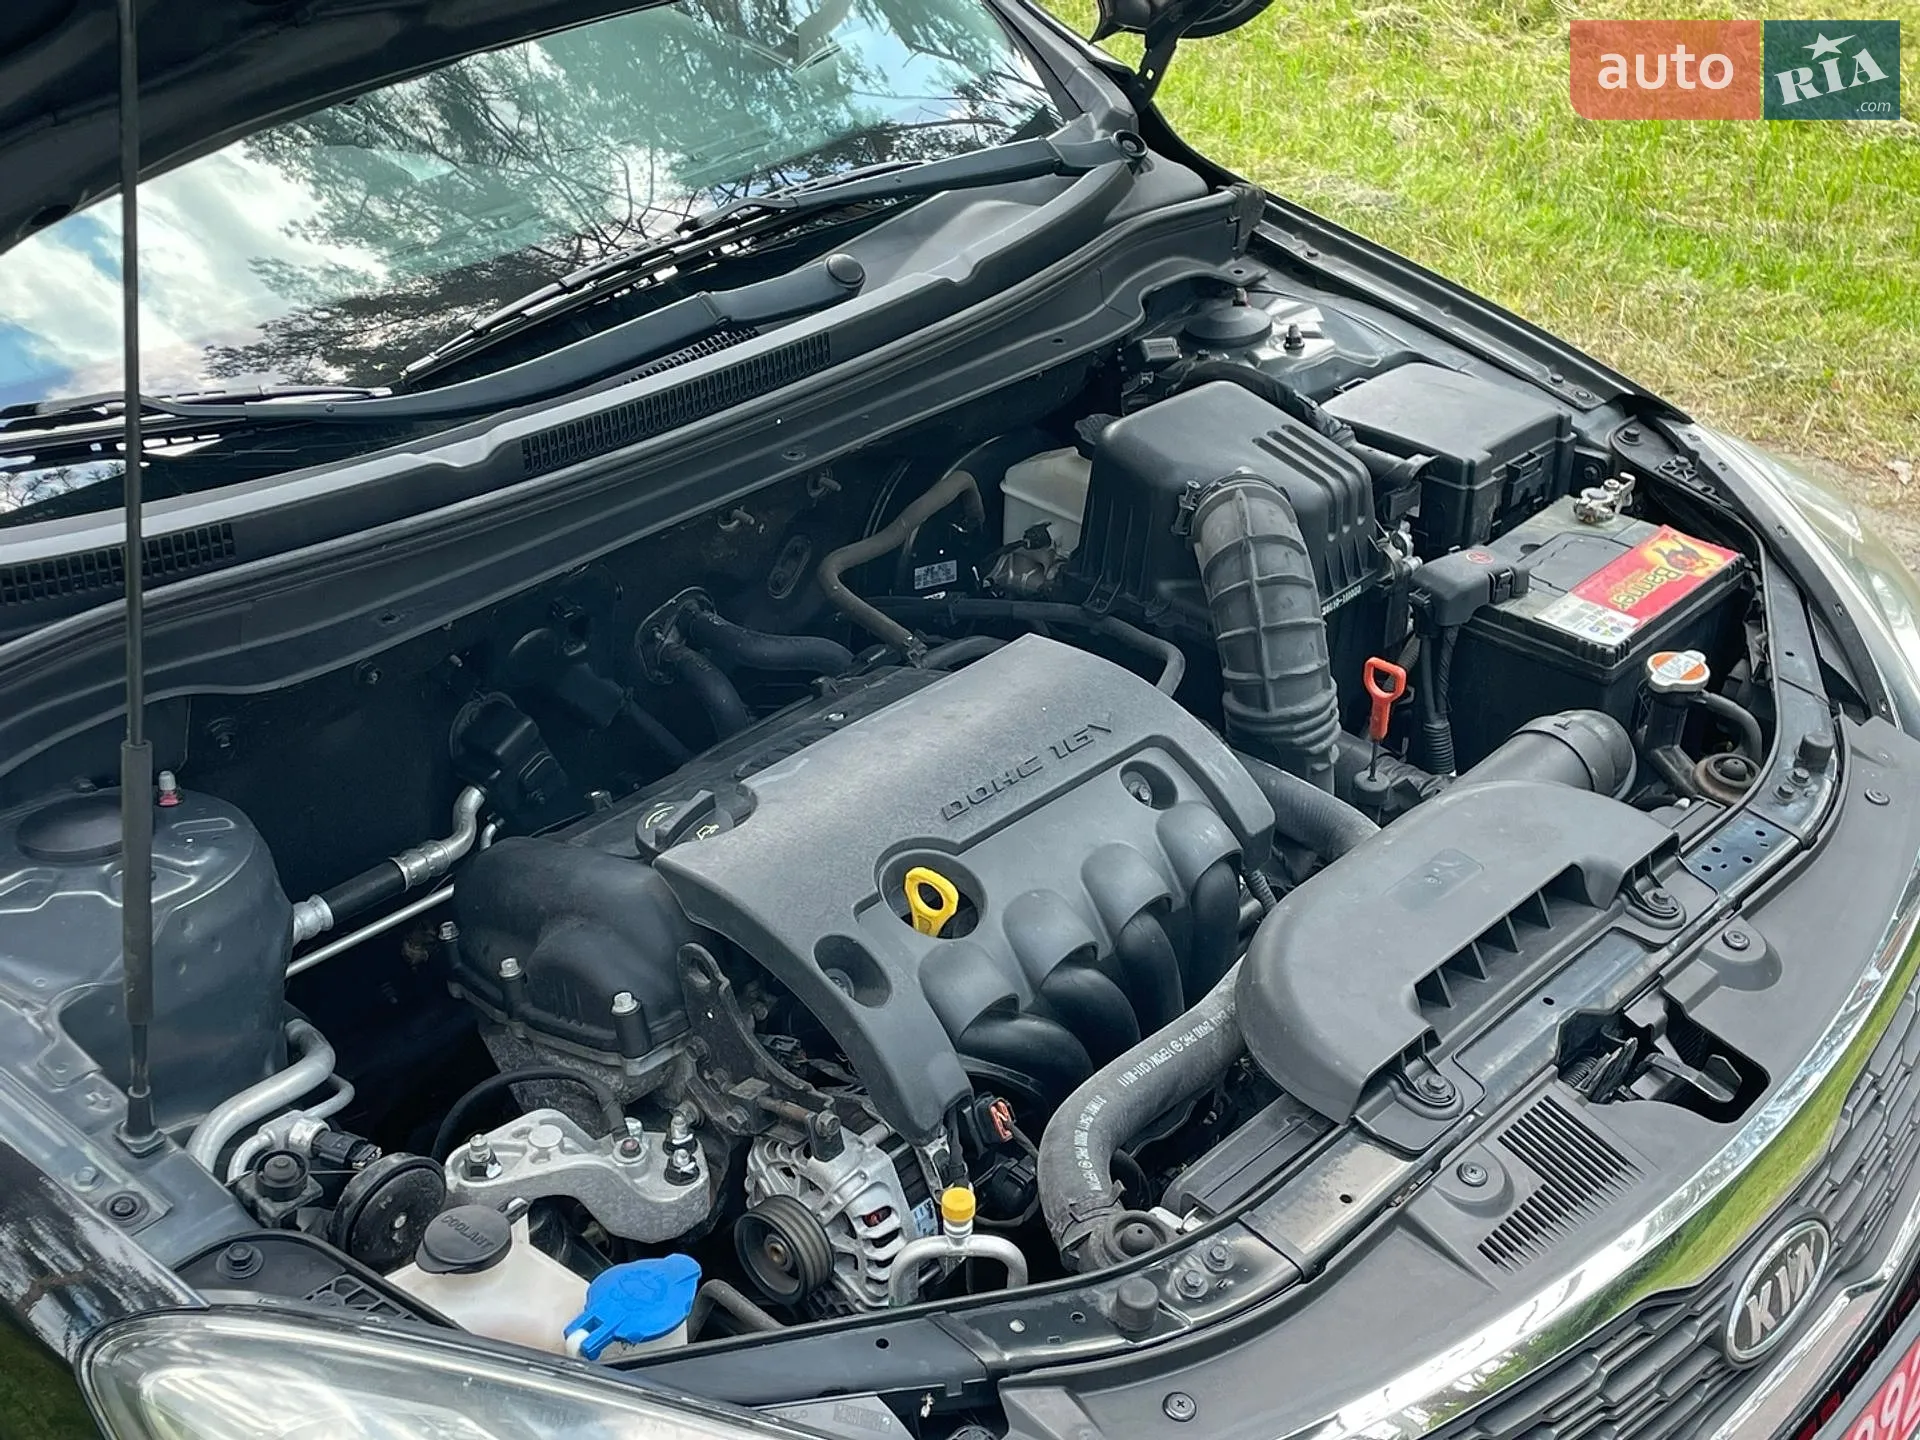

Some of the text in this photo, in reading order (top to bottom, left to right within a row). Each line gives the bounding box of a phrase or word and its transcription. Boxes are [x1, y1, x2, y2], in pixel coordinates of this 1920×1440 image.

[1612, 567, 1682, 609] Banner
[941, 711, 1113, 821] DOHC 16V
[441, 1214, 495, 1249] COOLANT
[1746, 1242, 1816, 1346] KIA
